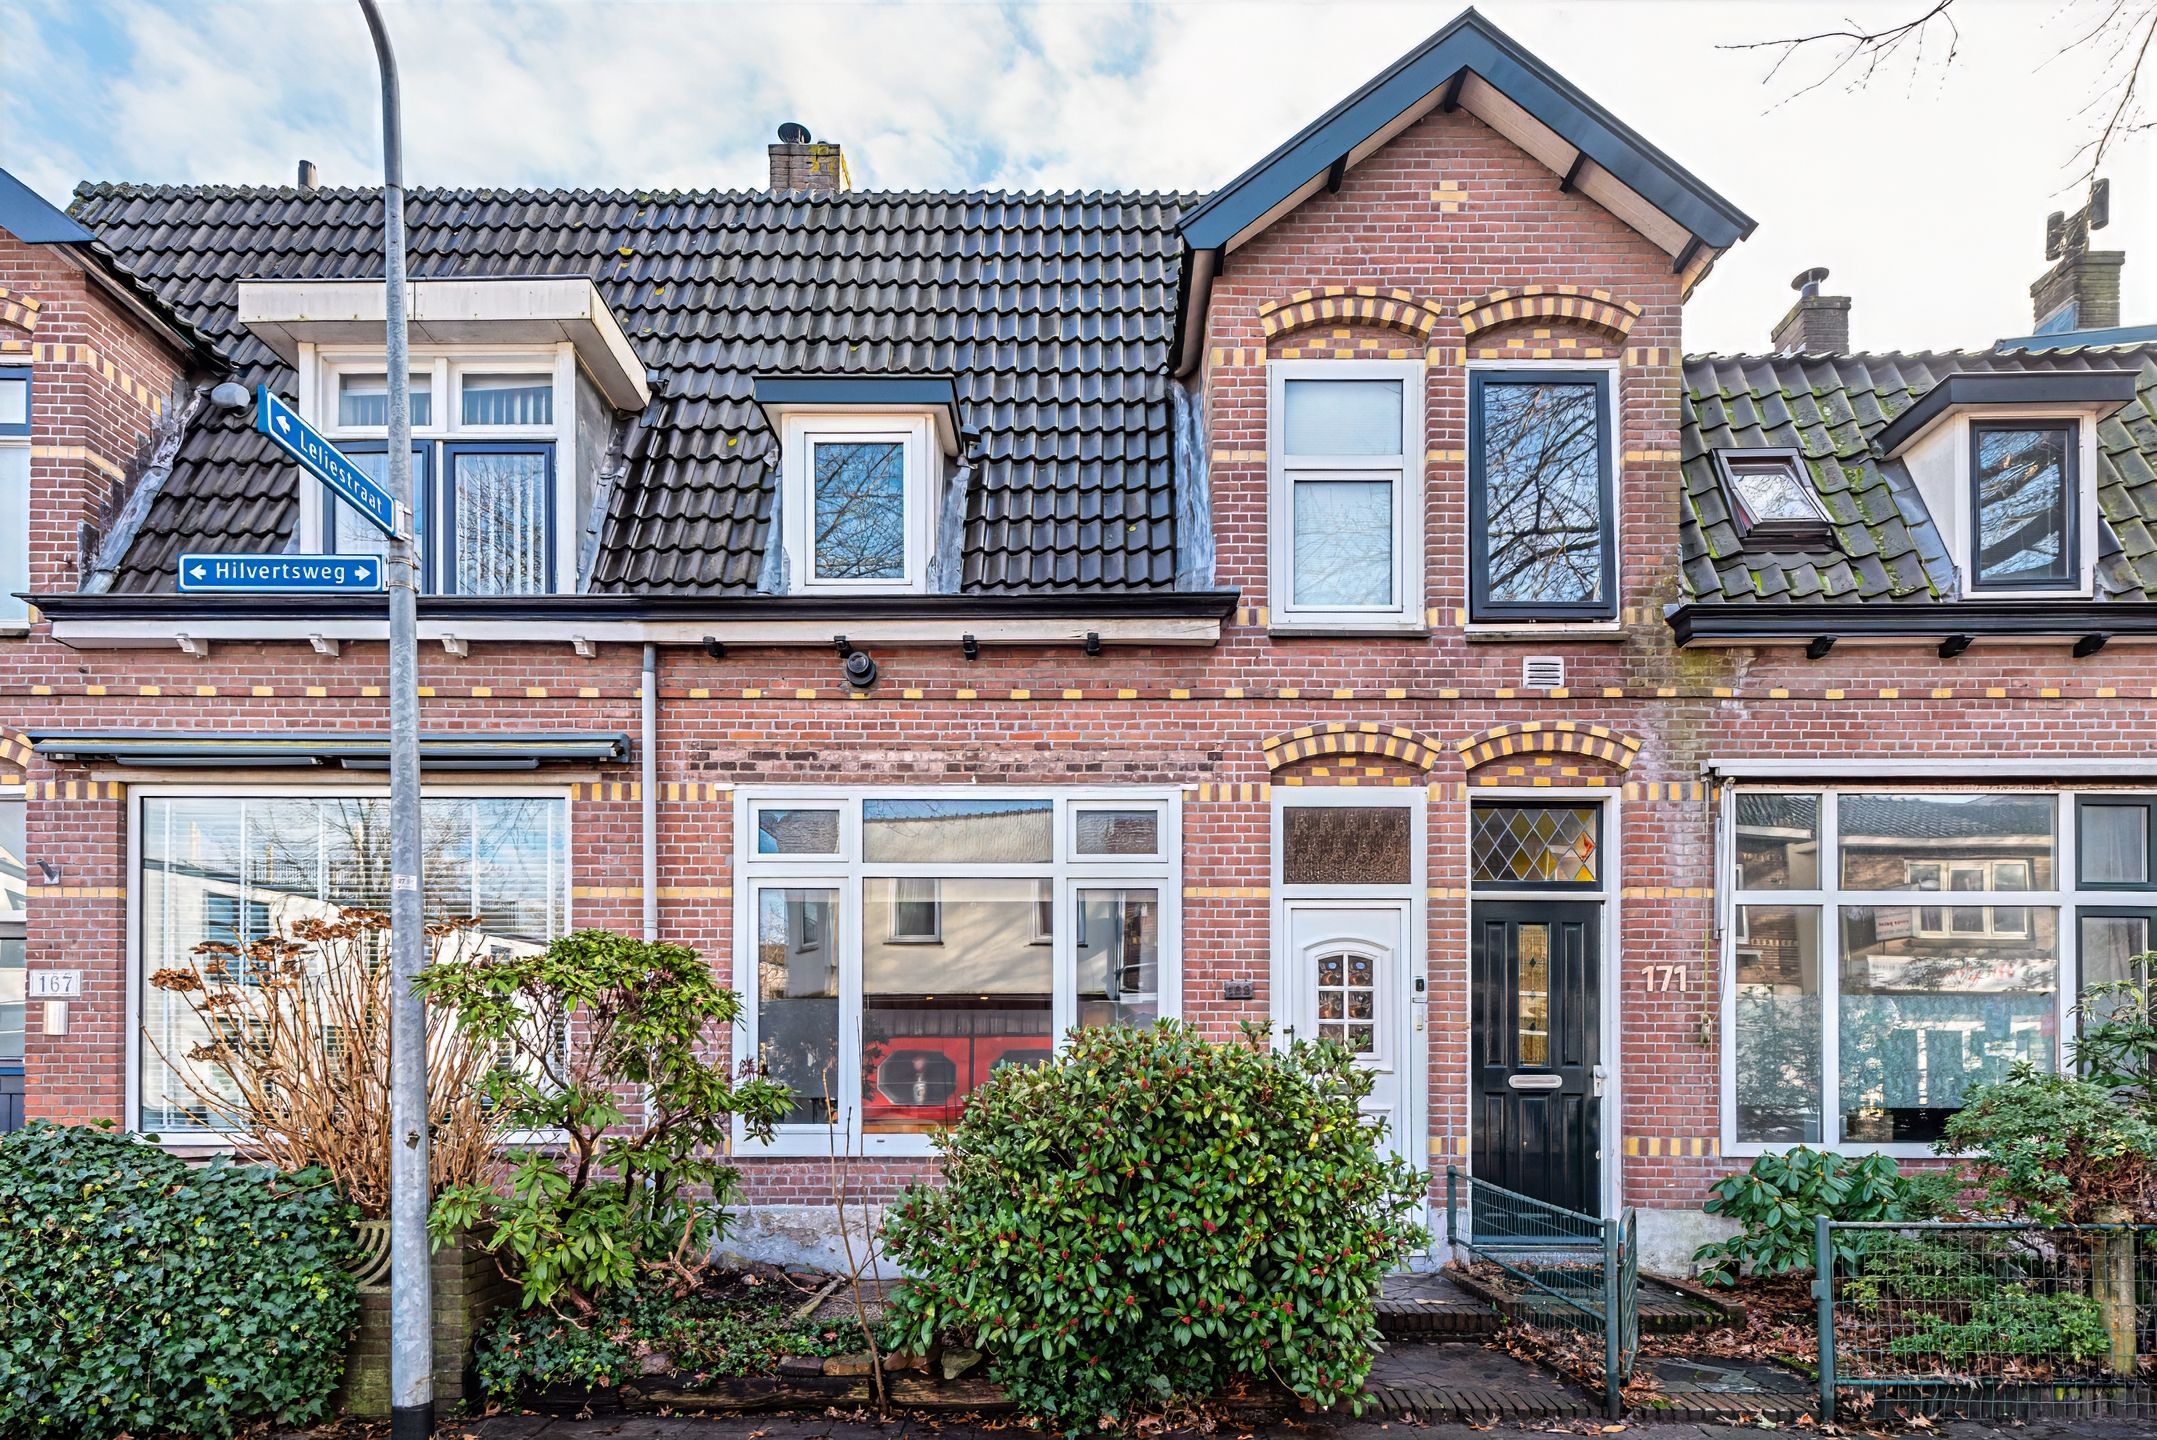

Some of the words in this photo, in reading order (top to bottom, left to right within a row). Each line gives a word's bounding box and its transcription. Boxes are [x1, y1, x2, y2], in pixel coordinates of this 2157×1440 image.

[300, 429, 383, 514] Leliestraat
[216, 562, 346, 584] Hilvertsweg
[40, 975, 73, 993] 167
[1641, 965, 1687, 992] 171
